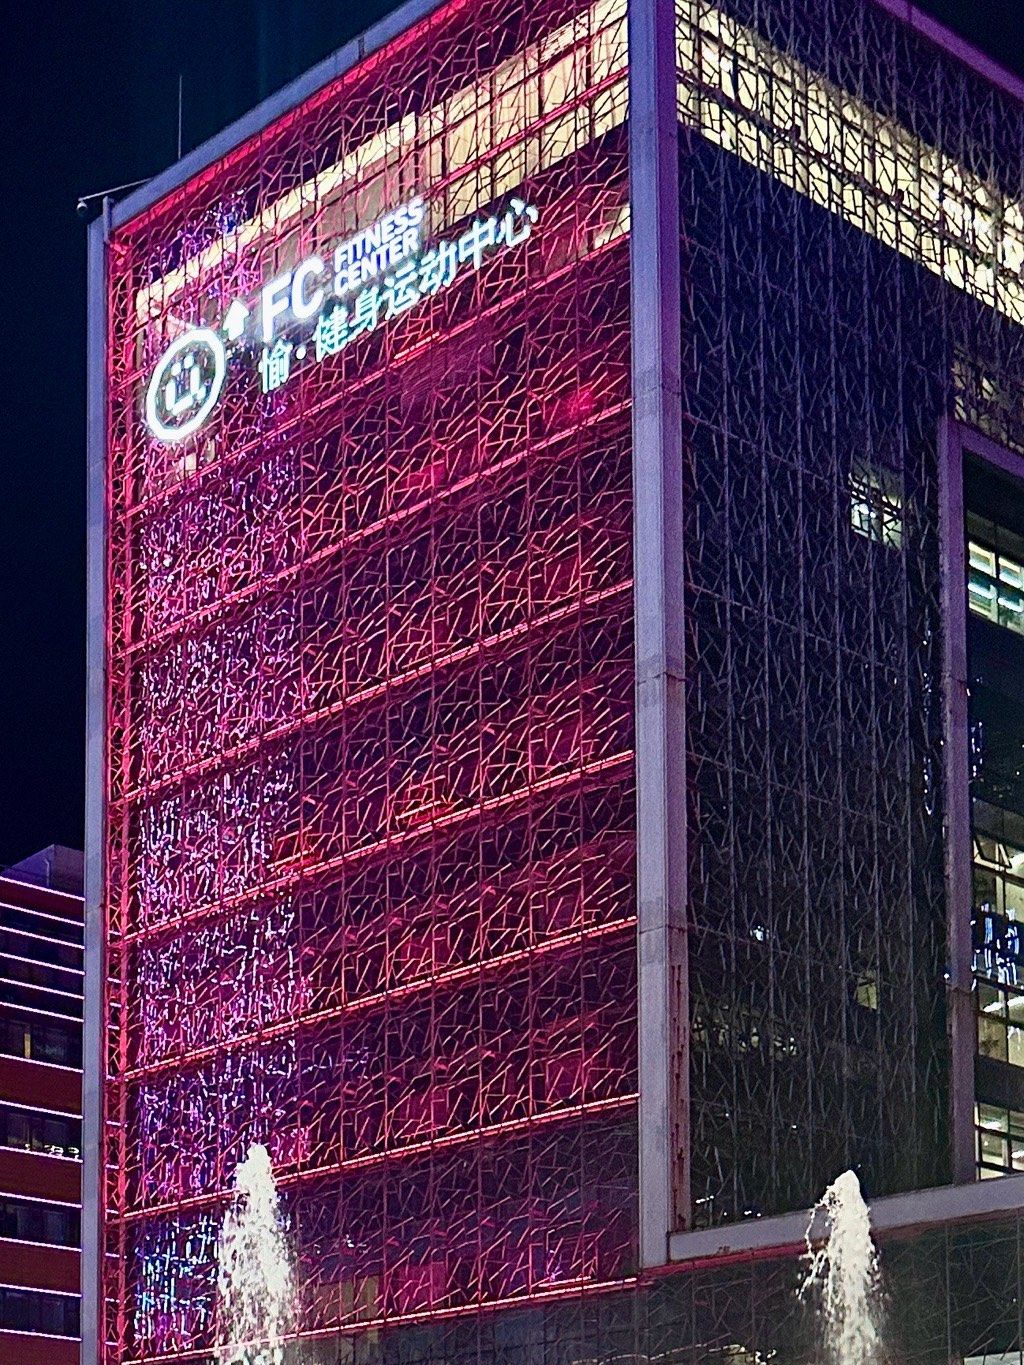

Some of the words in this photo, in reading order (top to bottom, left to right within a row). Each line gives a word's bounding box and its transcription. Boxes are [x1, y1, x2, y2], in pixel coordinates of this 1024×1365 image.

[334, 196, 425, 273] FITNESS
[334, 226, 420, 295] CENTER
[260, 257, 326, 342] FC
